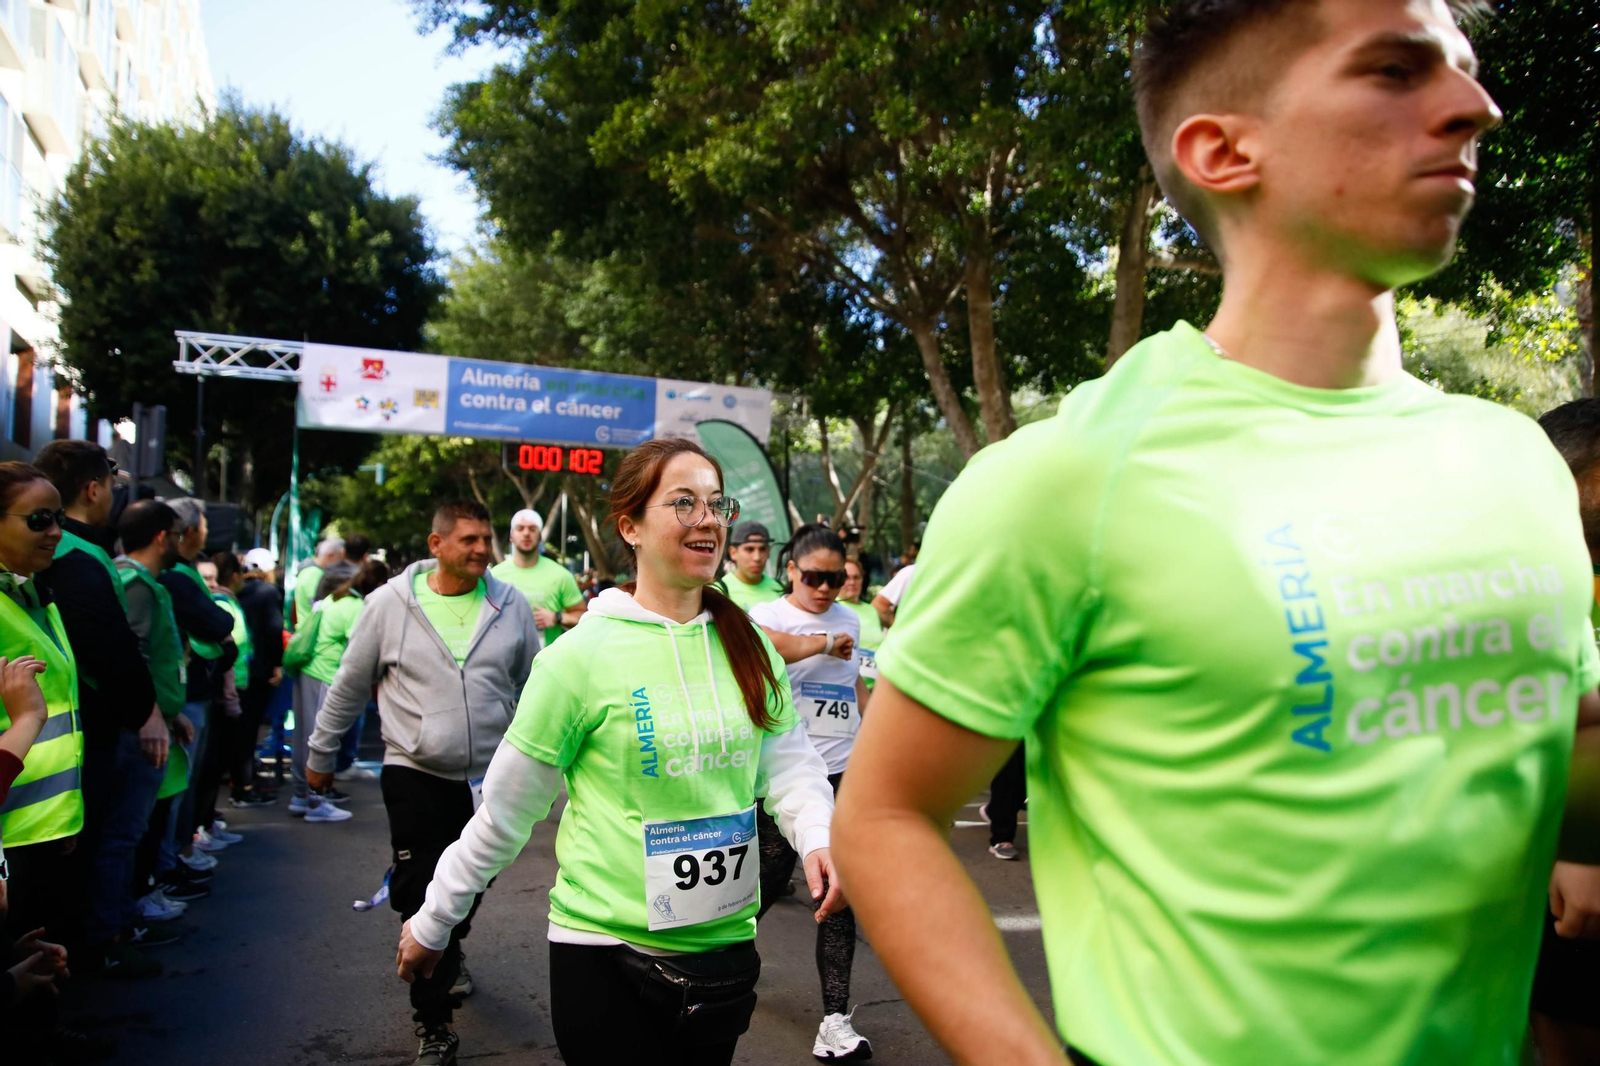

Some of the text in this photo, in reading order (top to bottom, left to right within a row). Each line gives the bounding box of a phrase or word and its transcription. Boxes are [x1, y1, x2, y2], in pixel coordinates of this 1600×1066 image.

[461, 367, 541, 391] Almería
[460, 392, 527, 412] contra
[531, 396, 551, 414] el
[555, 399, 623, 419] cáncer
[1331, 557, 1566, 618] En marcha
[1261, 522, 1333, 753] ALMERÍA
[1348, 602, 1568, 673] contra el
[658, 709, 683, 727] En
[814, 700, 850, 720] 749
[1346, 673, 1570, 746] cáncer
[630, 686, 660, 778] ALMERÍA
[739, 720, 754, 740] el
[665, 748, 753, 777] cáncer
[650, 831, 722, 846] contra el cáncer
[673, 844, 749, 891] 937
